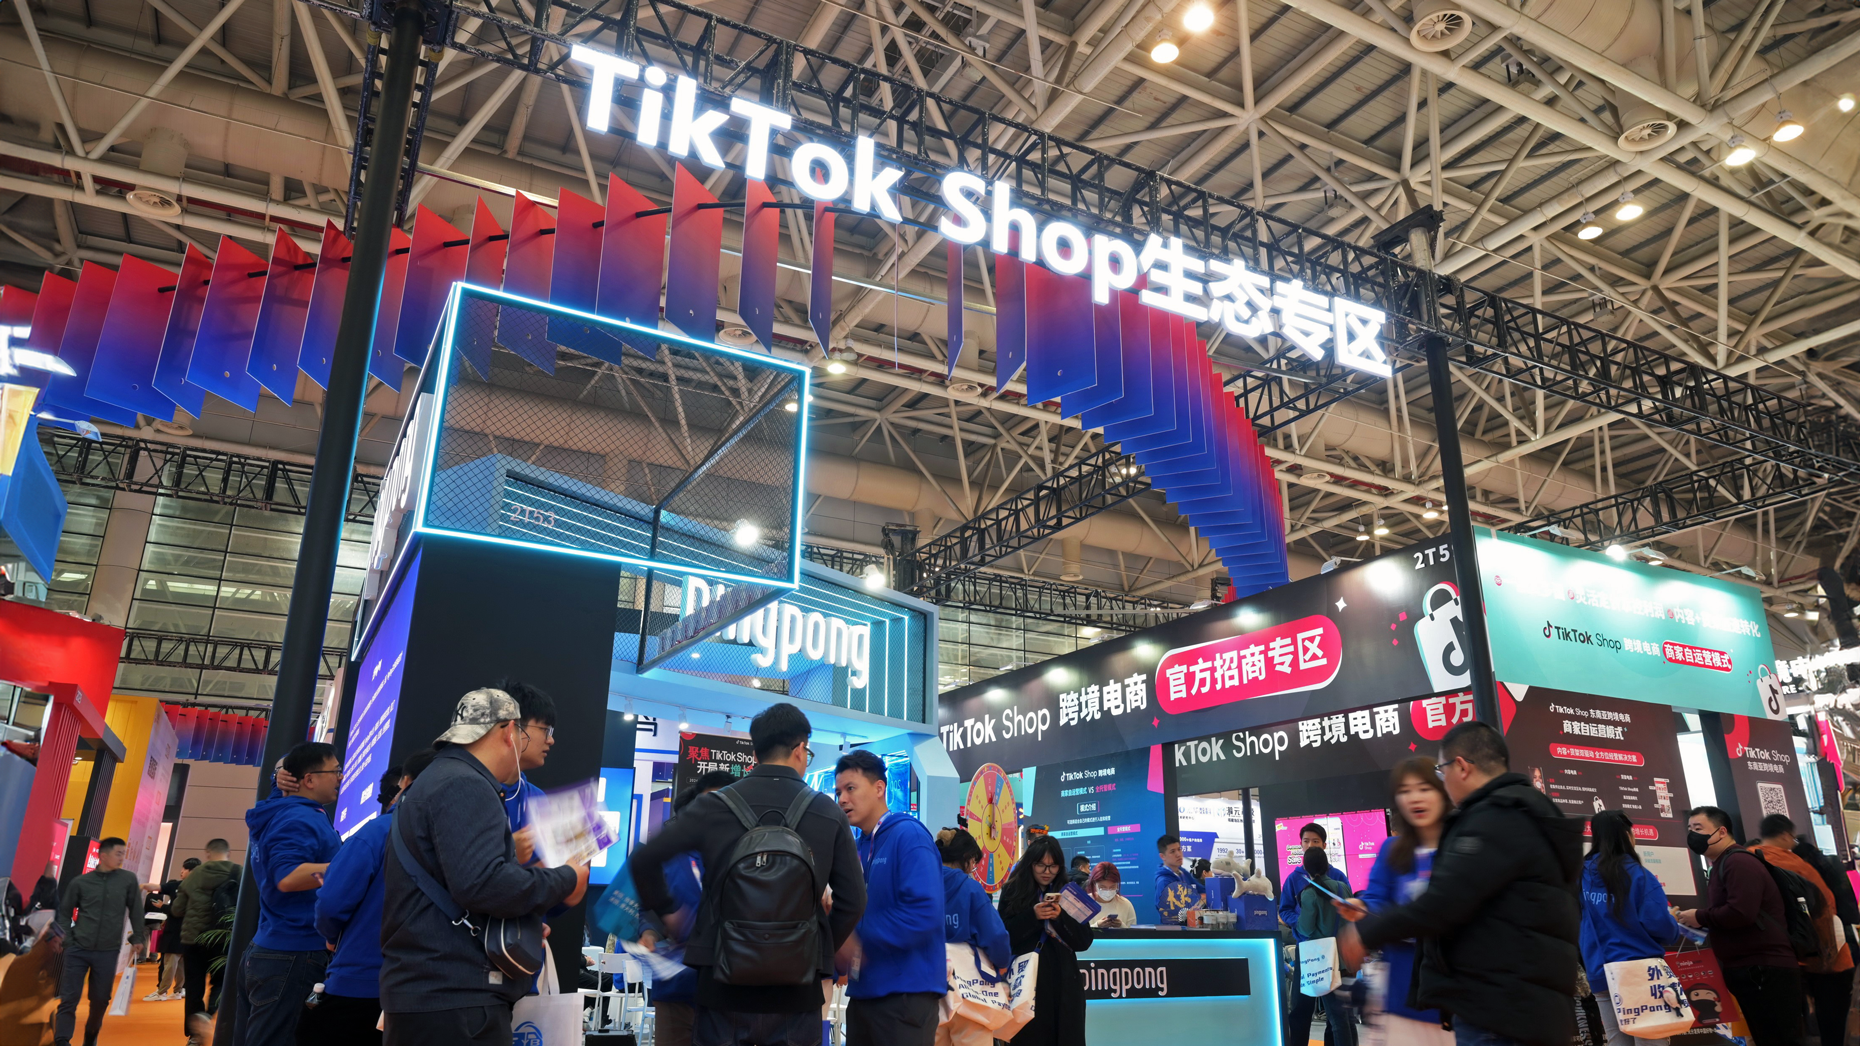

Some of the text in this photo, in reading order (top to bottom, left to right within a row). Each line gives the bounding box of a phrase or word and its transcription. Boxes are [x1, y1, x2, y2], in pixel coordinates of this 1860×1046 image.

[571, 45, 903, 224] TikTok
[510, 504, 556, 528] 2T53
[1413, 543, 1454, 570] 2T5
[1554, 626, 1732, 670] TikTok Shop 跨境电商 商家自运营模式
[940, 626, 1328, 752] TikTok Shop 跨境电商 官方招商专区
[1555, 705, 1575, 716] TikTok
[1575, 708, 1589, 718] Shop
[1174, 692, 1475, 768] kTok Shop 跨境电商 官方
[1562, 720, 1624, 740] 商家自运营模式
[686, 745, 710, 764] 聚焦
[711, 749, 737, 762] TikTok
[1743, 746, 1791, 765] TikTok Shop
[1066, 772, 1083, 781] TikTok
[1084, 770, 1097, 779] Shop
[1617, 1004, 1671, 1017] PingPong
